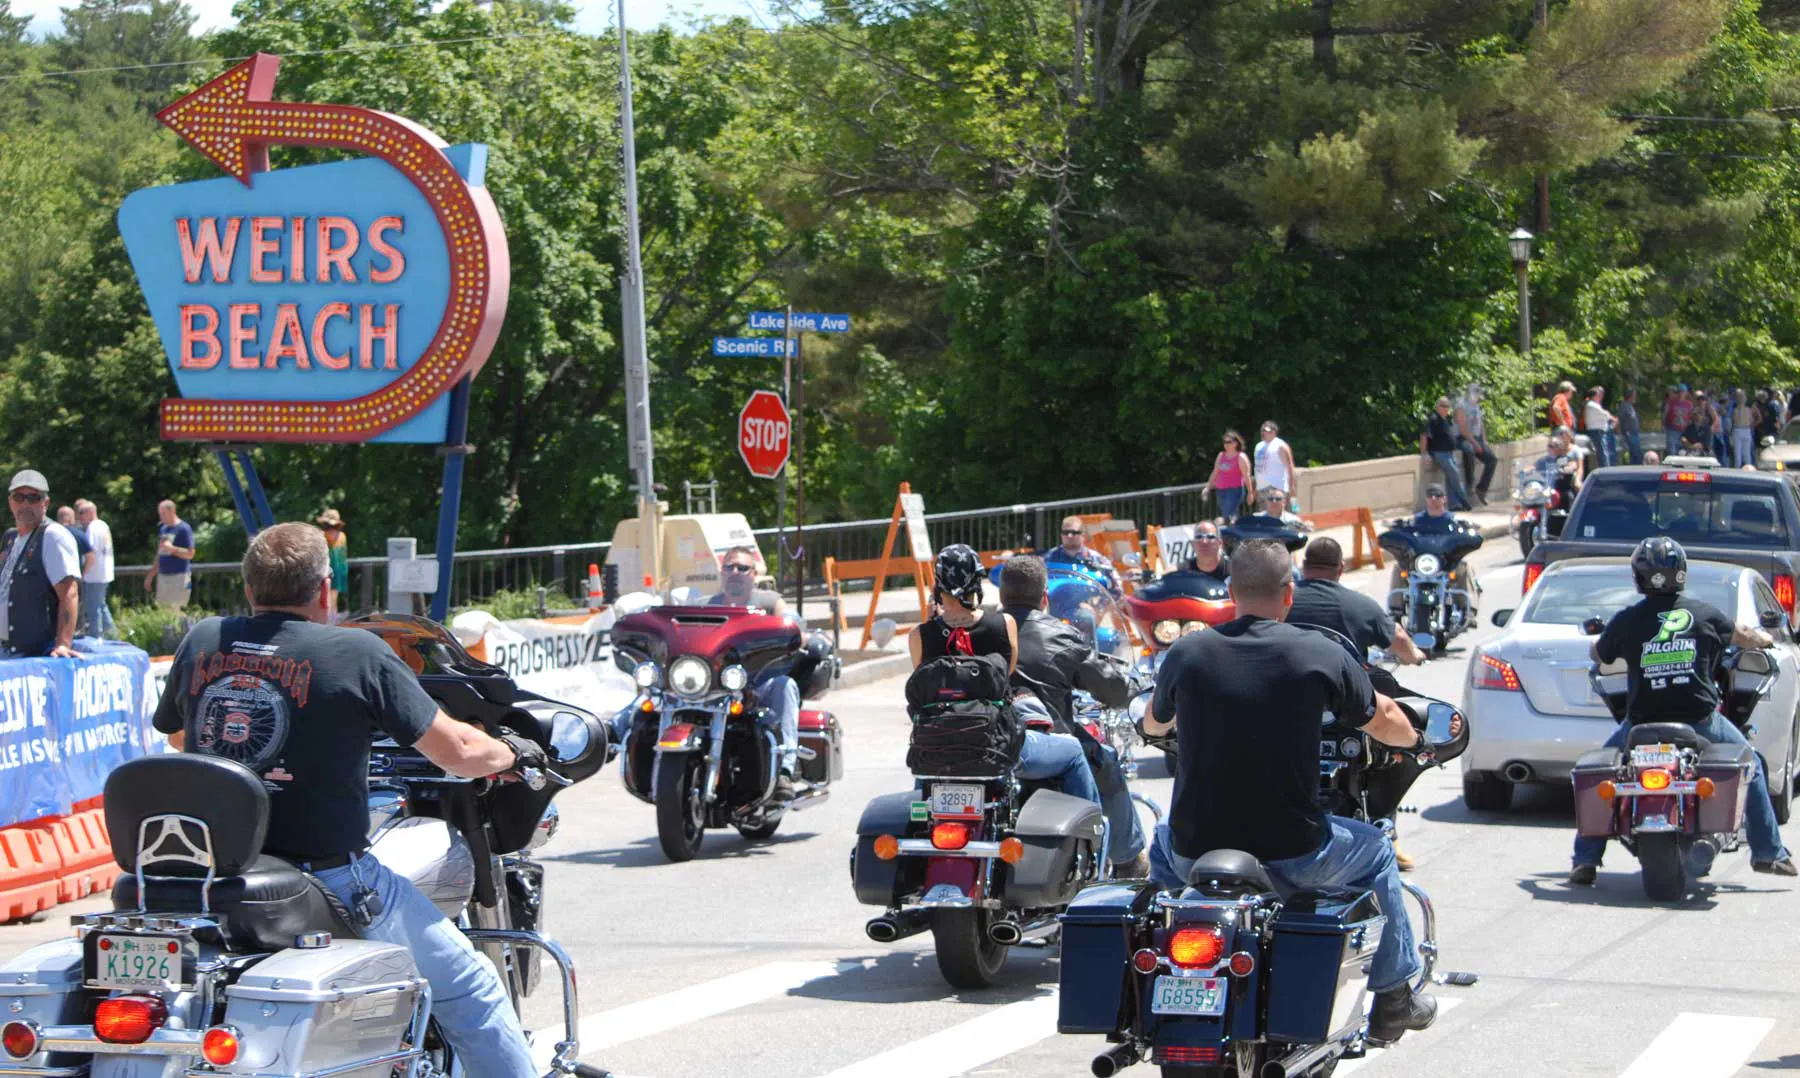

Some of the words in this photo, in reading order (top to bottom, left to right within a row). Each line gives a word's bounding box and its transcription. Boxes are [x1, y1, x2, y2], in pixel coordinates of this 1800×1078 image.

[174, 215, 407, 284] WEIRS
[821, 318, 847, 330] Ave
[178, 302, 402, 370] BEACH
[716, 340, 768, 353] Scenic
[743, 417, 787, 452] STOP
[1644, 640, 1695, 655] PILGRIM
[940, 792, 974, 806] 32897
[107, 953, 170, 979] K1926
[1162, 988, 1217, 1007] G8555
